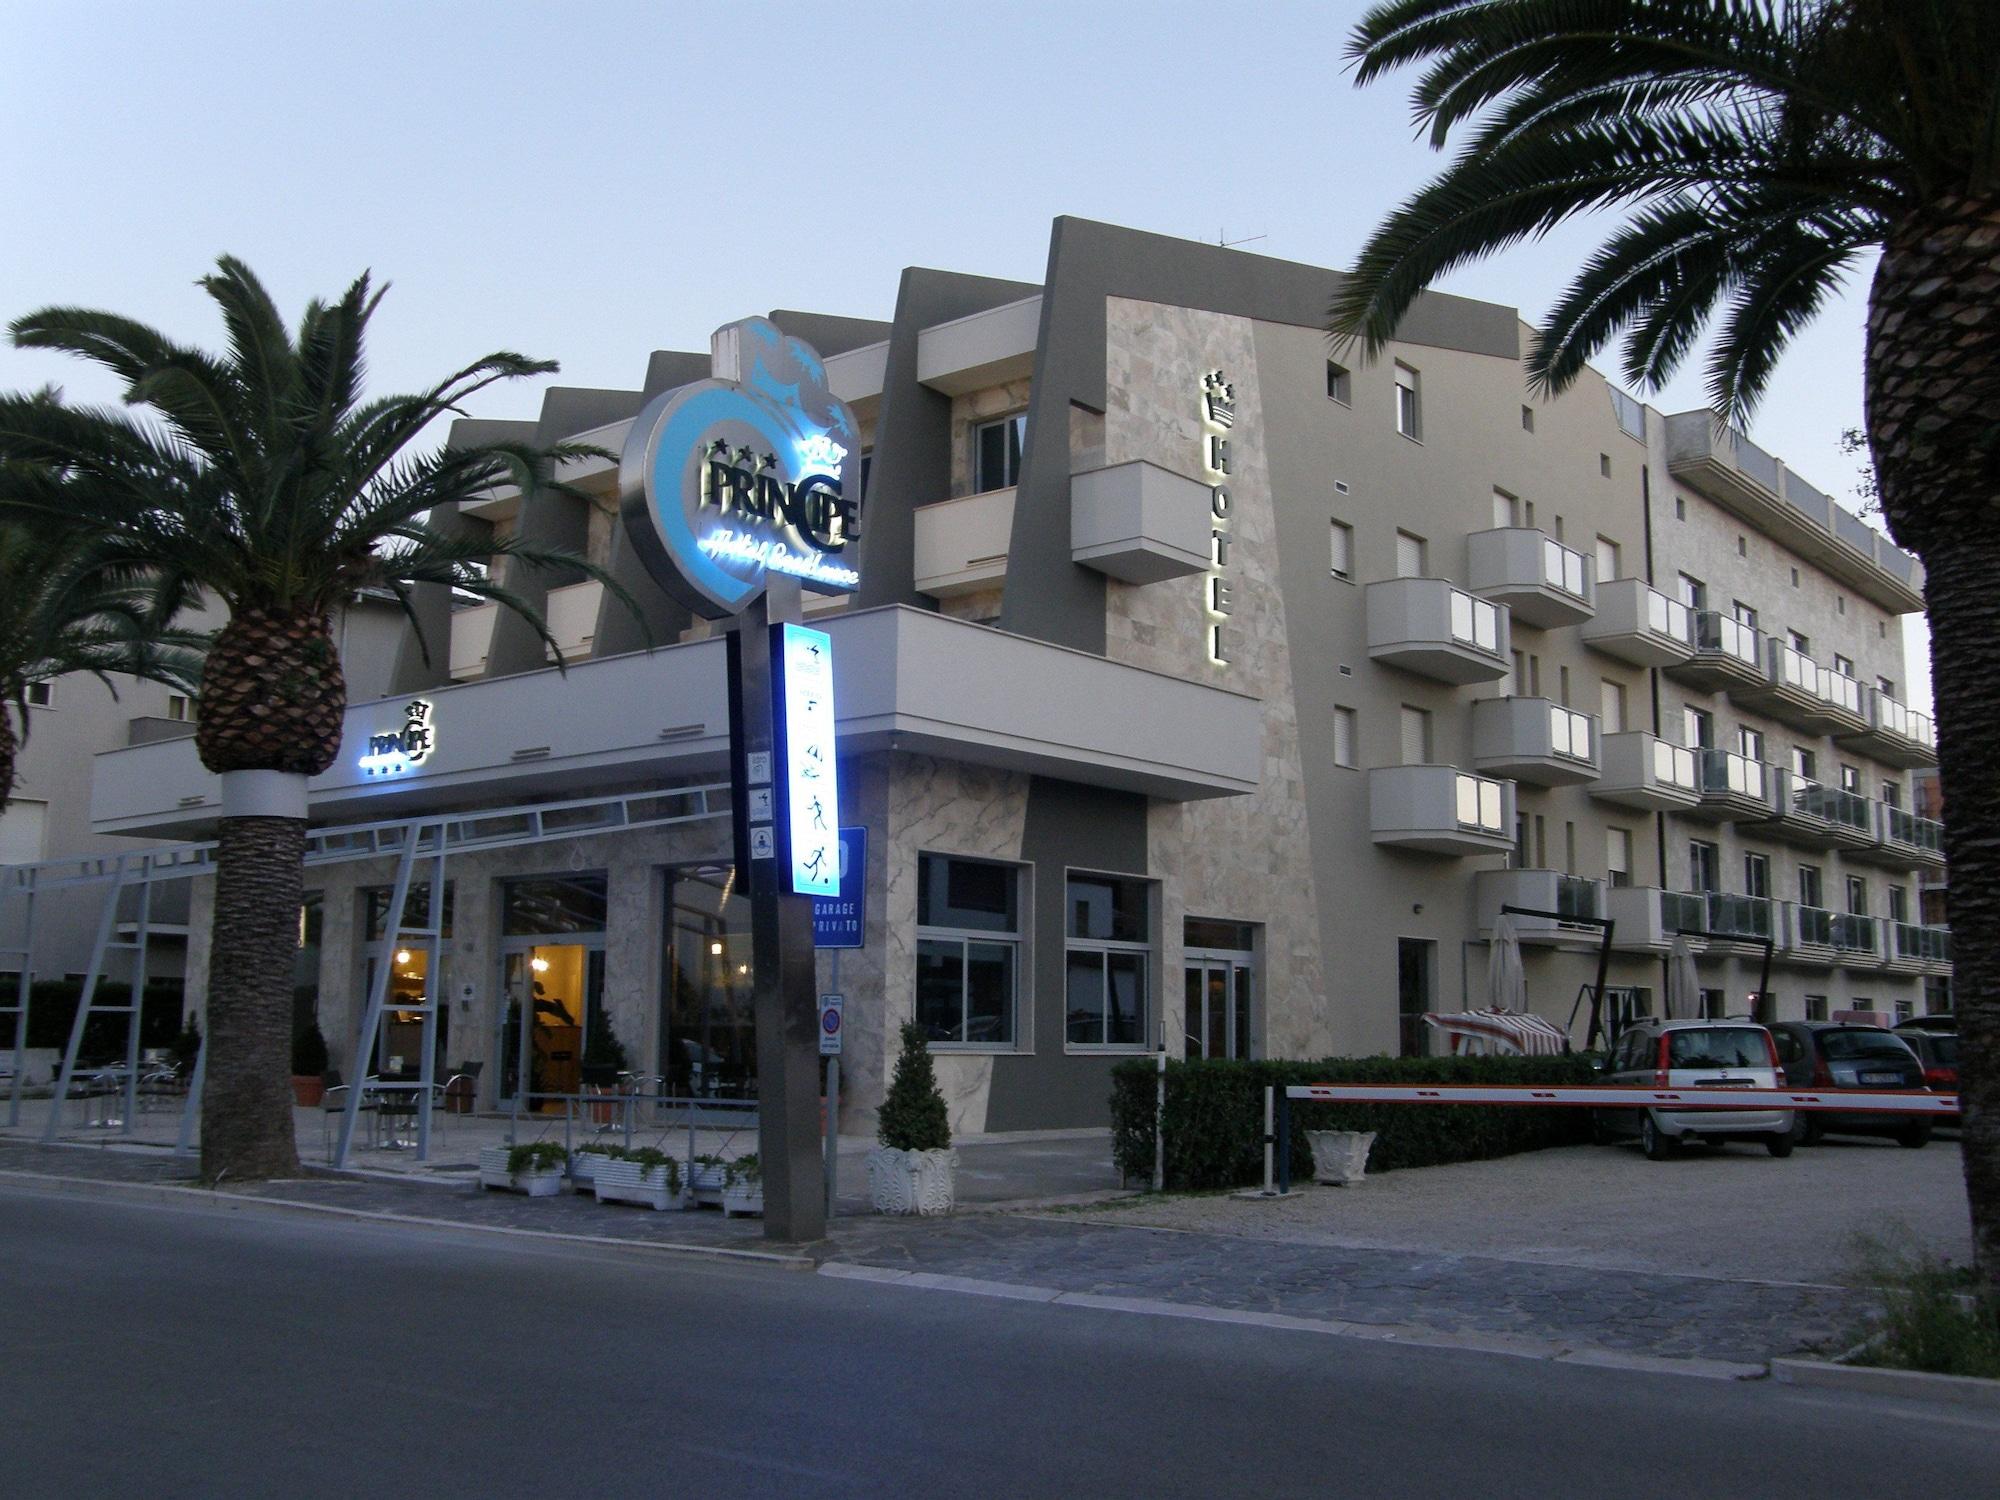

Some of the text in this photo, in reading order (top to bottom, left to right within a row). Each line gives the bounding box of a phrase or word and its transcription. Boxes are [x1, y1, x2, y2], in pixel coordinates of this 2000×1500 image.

[709, 460, 861, 554] PRINCIPE
[1210, 435, 1233, 664] HOTEL
[814, 903, 855, 915] GARAGE
